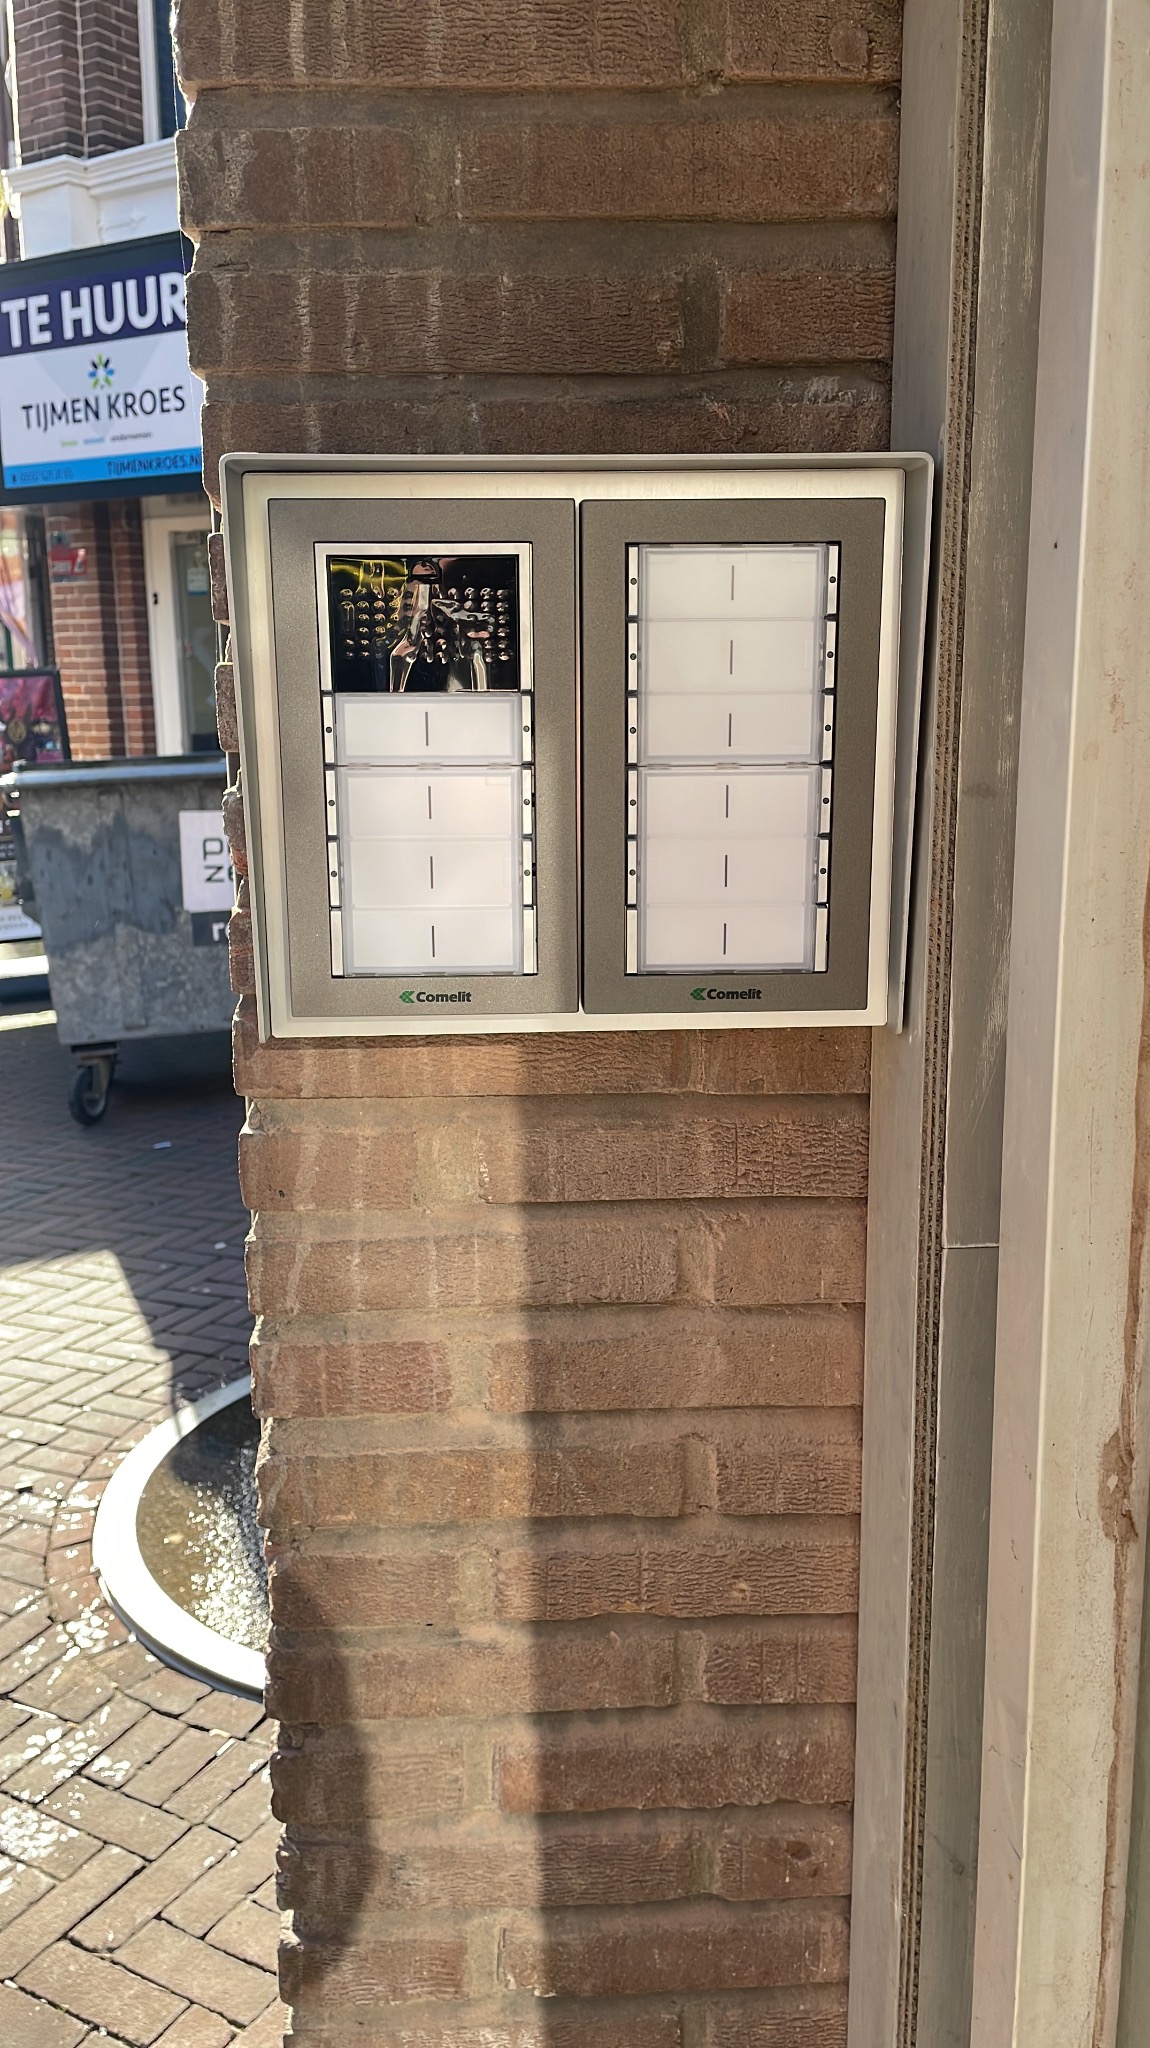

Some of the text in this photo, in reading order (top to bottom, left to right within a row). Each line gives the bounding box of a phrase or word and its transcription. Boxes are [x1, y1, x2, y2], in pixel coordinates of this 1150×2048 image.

[1, 271, 187, 348] TE HUUR
[21, 385, 186, 434] TIJMEN KROES
[416, 991, 472, 1003] Comelit
[706, 988, 762, 1000] Comelit
